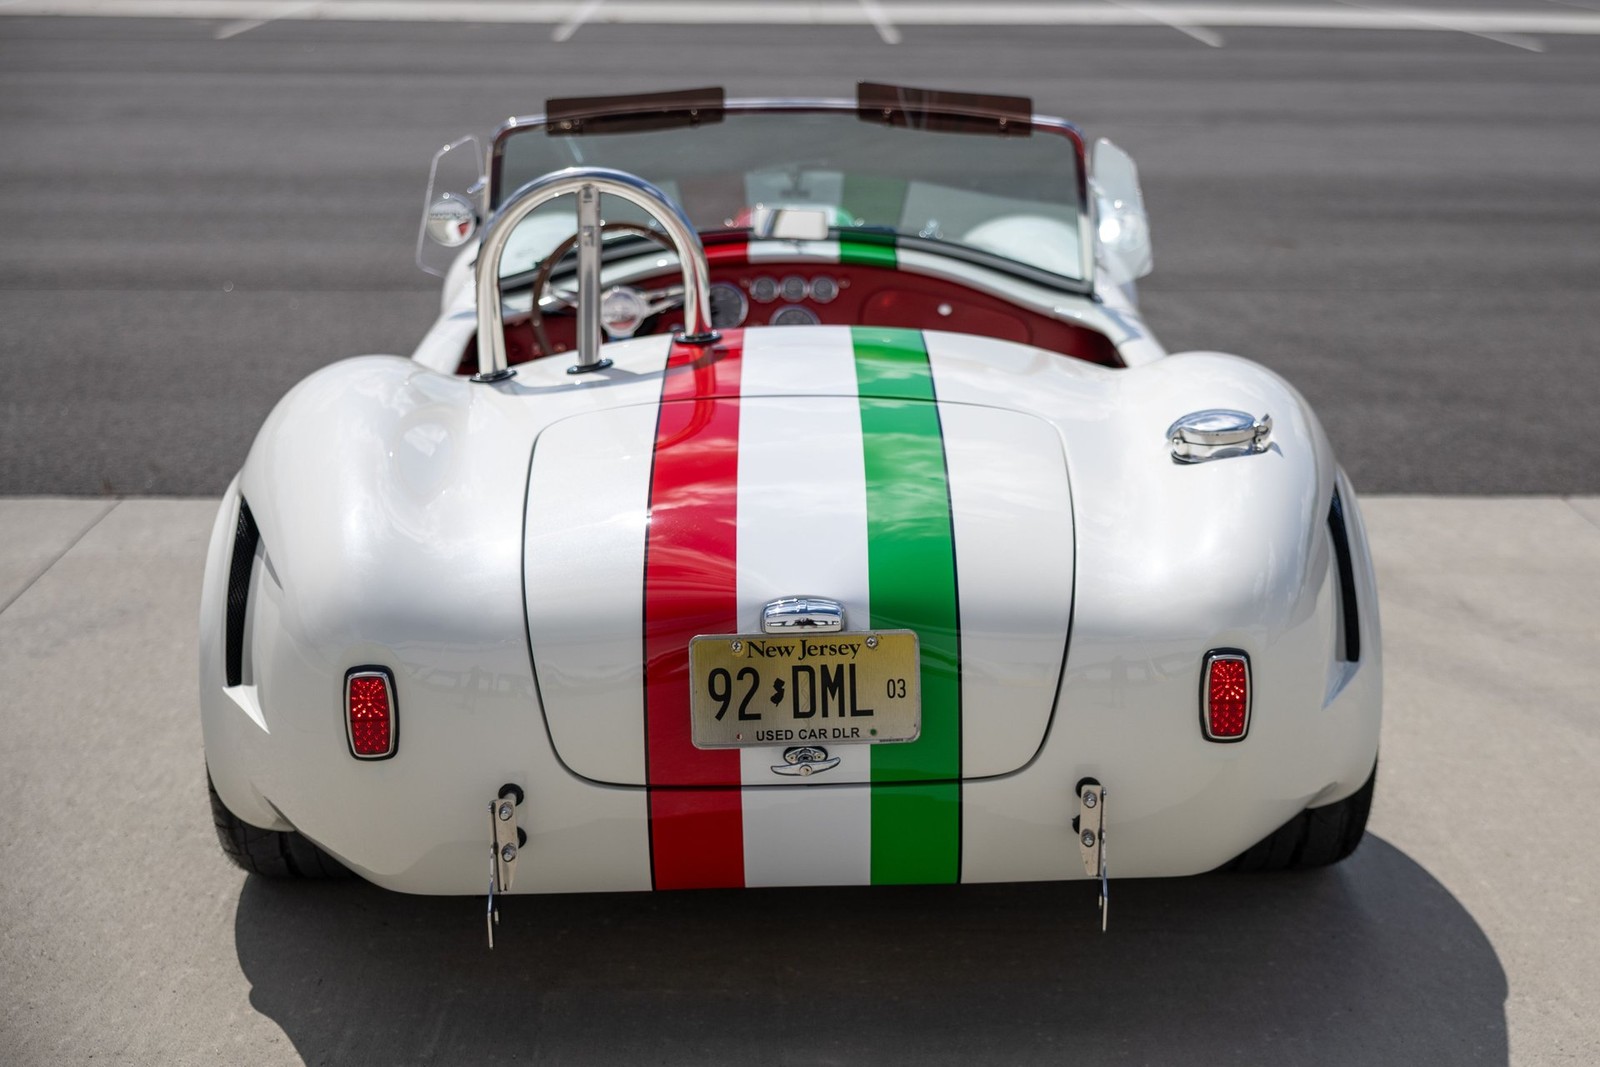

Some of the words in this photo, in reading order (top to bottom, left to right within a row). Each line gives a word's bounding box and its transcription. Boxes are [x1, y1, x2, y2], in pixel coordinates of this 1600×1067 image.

[747, 641, 795, 658] New
[798, 640, 860, 660] Jersey
[708, 667, 762, 721] 92
[791, 664, 874, 719] DML
[886, 678, 907, 699] 03
[756, 730, 794, 741] USED
[798, 729, 828, 740] CAR
[832, 727, 860, 739] DLR
